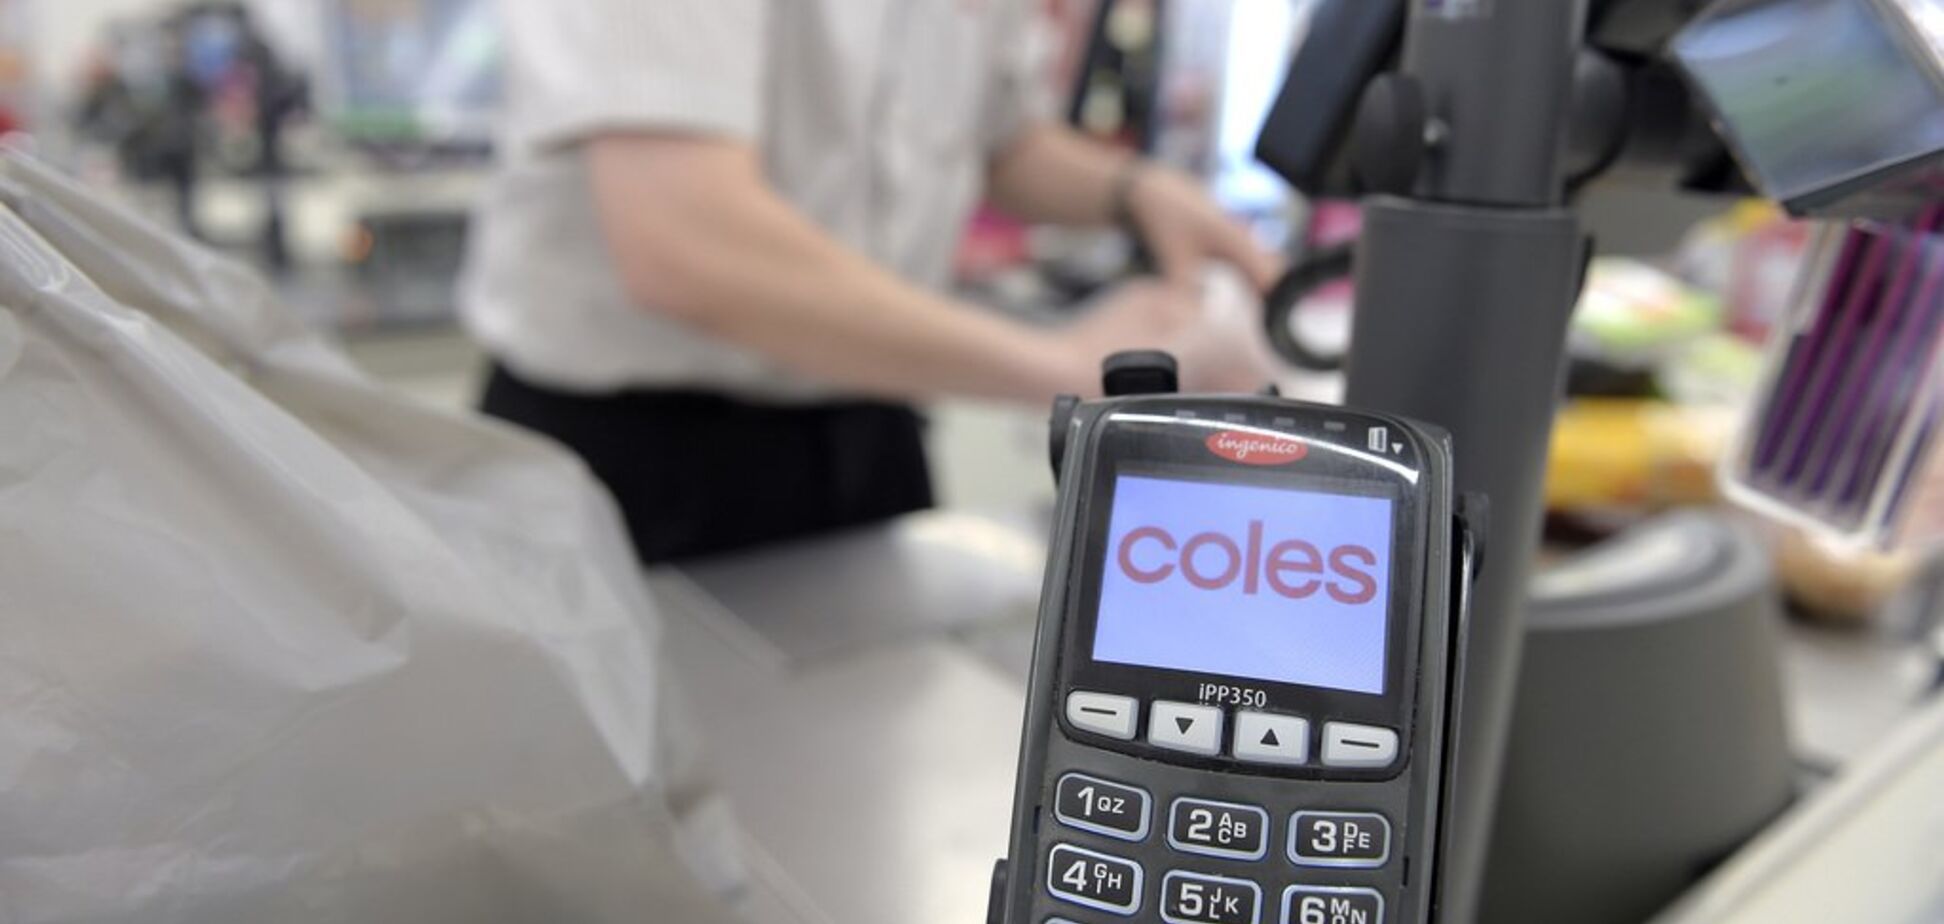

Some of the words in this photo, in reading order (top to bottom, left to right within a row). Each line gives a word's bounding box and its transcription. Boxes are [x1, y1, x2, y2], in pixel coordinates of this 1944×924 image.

[1217, 431, 1298, 459] ingenico
[1117, 519, 1377, 606] coles
[1199, 683, 1268, 708] iPP350
